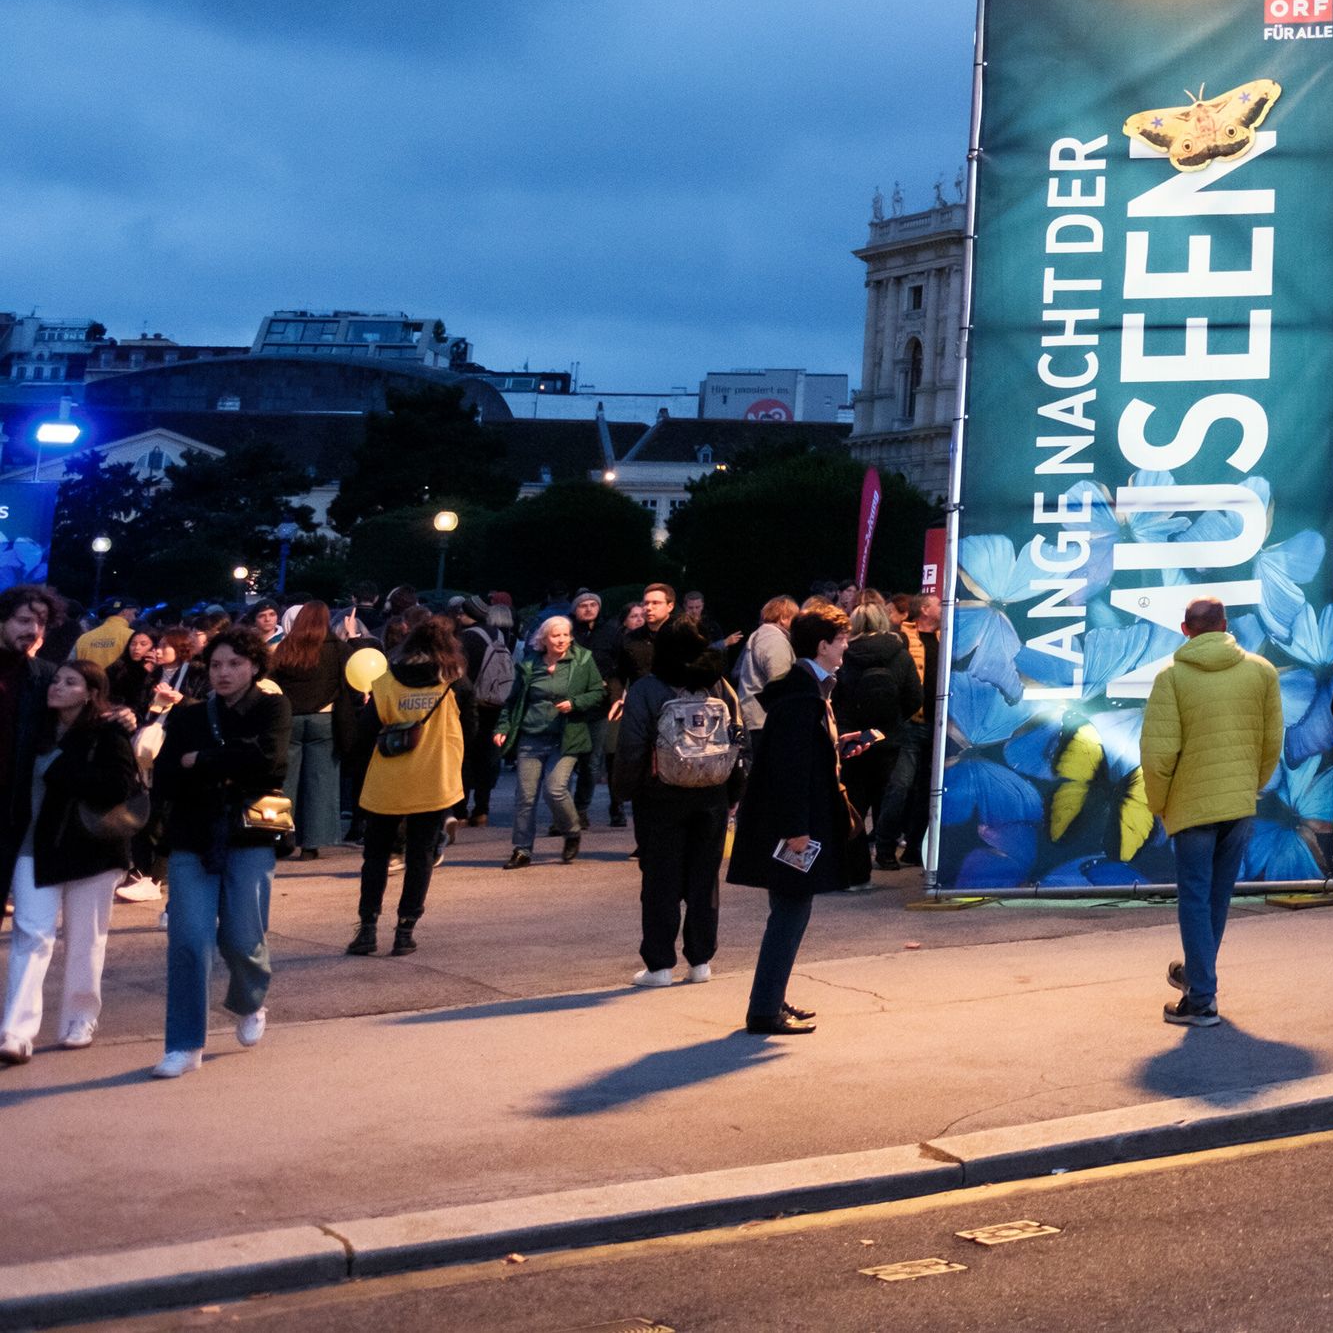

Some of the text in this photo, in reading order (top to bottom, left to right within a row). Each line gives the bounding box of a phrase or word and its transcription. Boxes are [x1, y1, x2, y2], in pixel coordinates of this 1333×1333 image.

[1264, 24, 1333, 40] FÜR ALLE
[1023, 134, 1108, 701] LANGE NACHT DER
